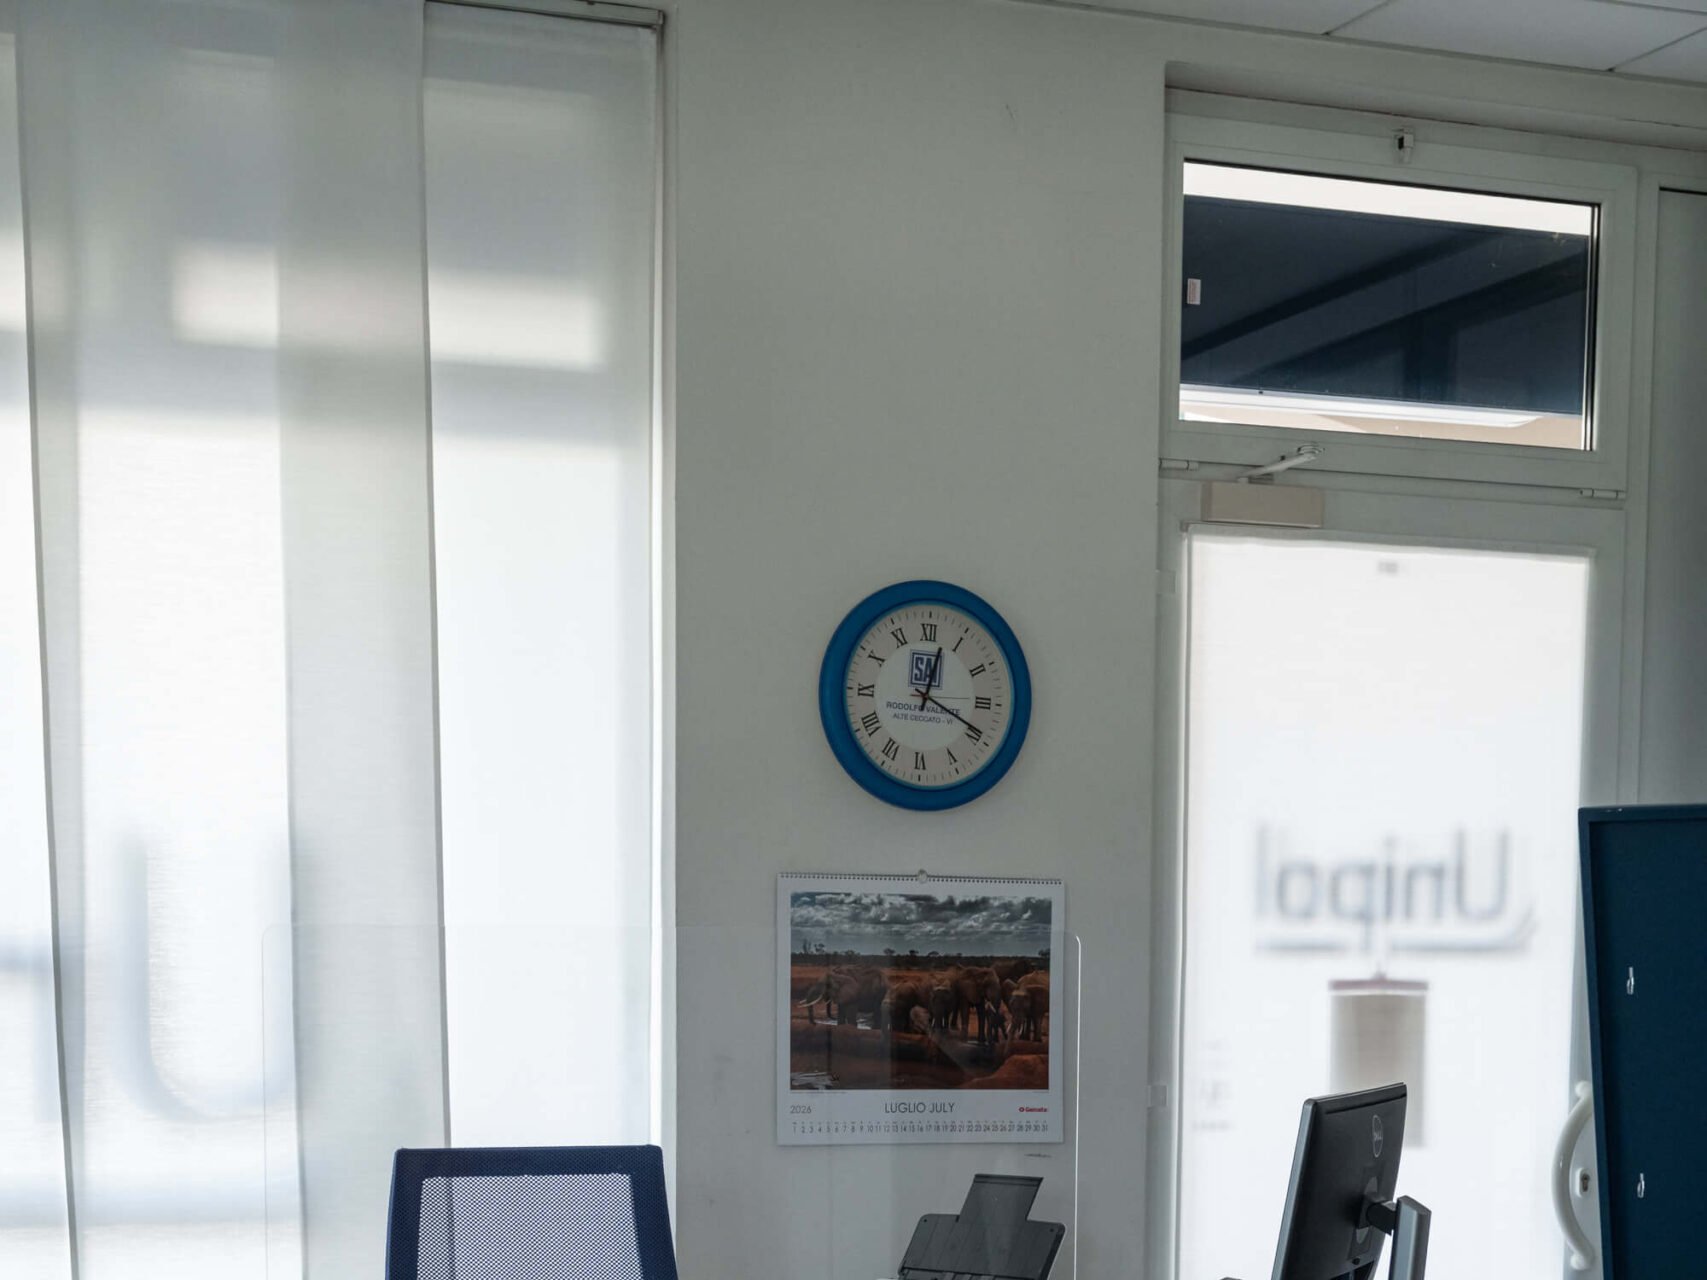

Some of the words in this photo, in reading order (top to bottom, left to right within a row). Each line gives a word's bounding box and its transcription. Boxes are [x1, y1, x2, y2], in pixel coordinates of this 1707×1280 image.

[890, 627, 908, 649] XI
[919, 623, 938, 643] XII
[868, 650, 886, 668] X
[969, 663, 987, 678] II
[857, 683, 875, 699] IX
[974, 696, 992, 711] III
[861, 711, 882, 737] VIII
[881, 737, 900, 762] VII
[946, 747, 958, 766] V
[914, 751, 927, 771] VI
[790, 1105, 812, 1114] 2026
[884, 1102, 926, 1114] LUGLIO
[929, 1102, 955, 1113] JULY
